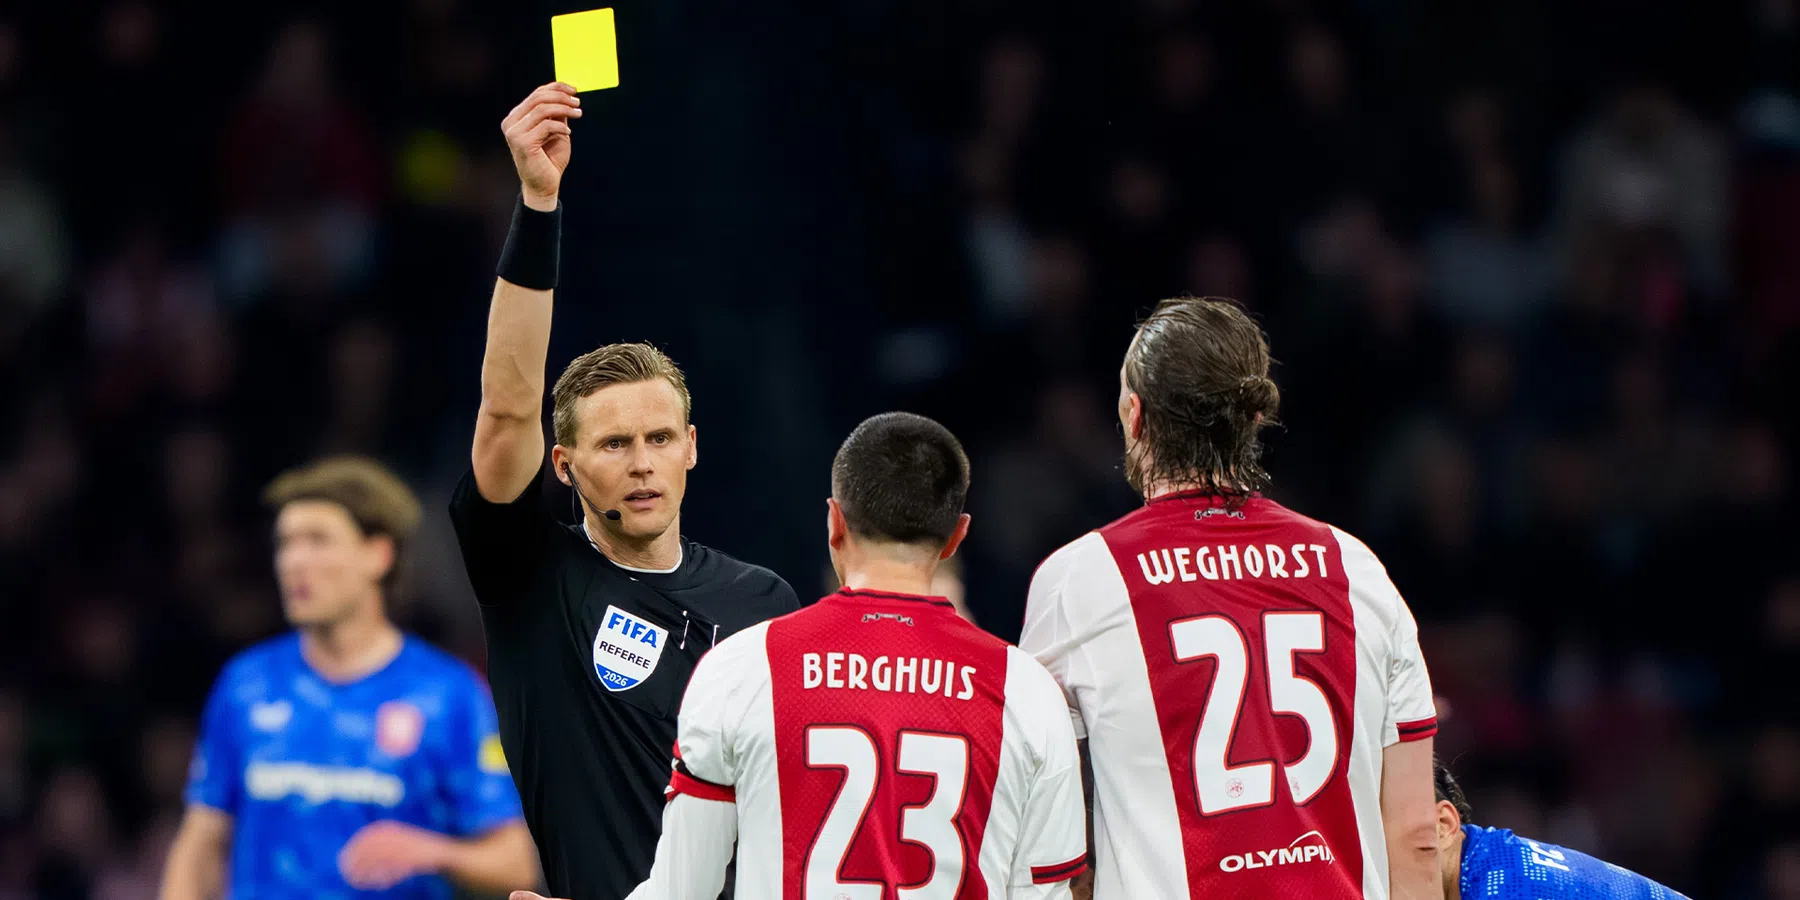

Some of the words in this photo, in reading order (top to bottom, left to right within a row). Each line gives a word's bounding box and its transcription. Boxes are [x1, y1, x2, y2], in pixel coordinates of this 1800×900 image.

[1137, 544, 1327, 585] WEGHORST
[607, 612, 657, 649] FIFA
[599, 640, 651, 669] REFEREE
[603, 670, 628, 687] 2026
[803, 652, 976, 700] BERGHUIS
[1170, 610, 1340, 813] 25
[803, 725, 969, 900] 23
